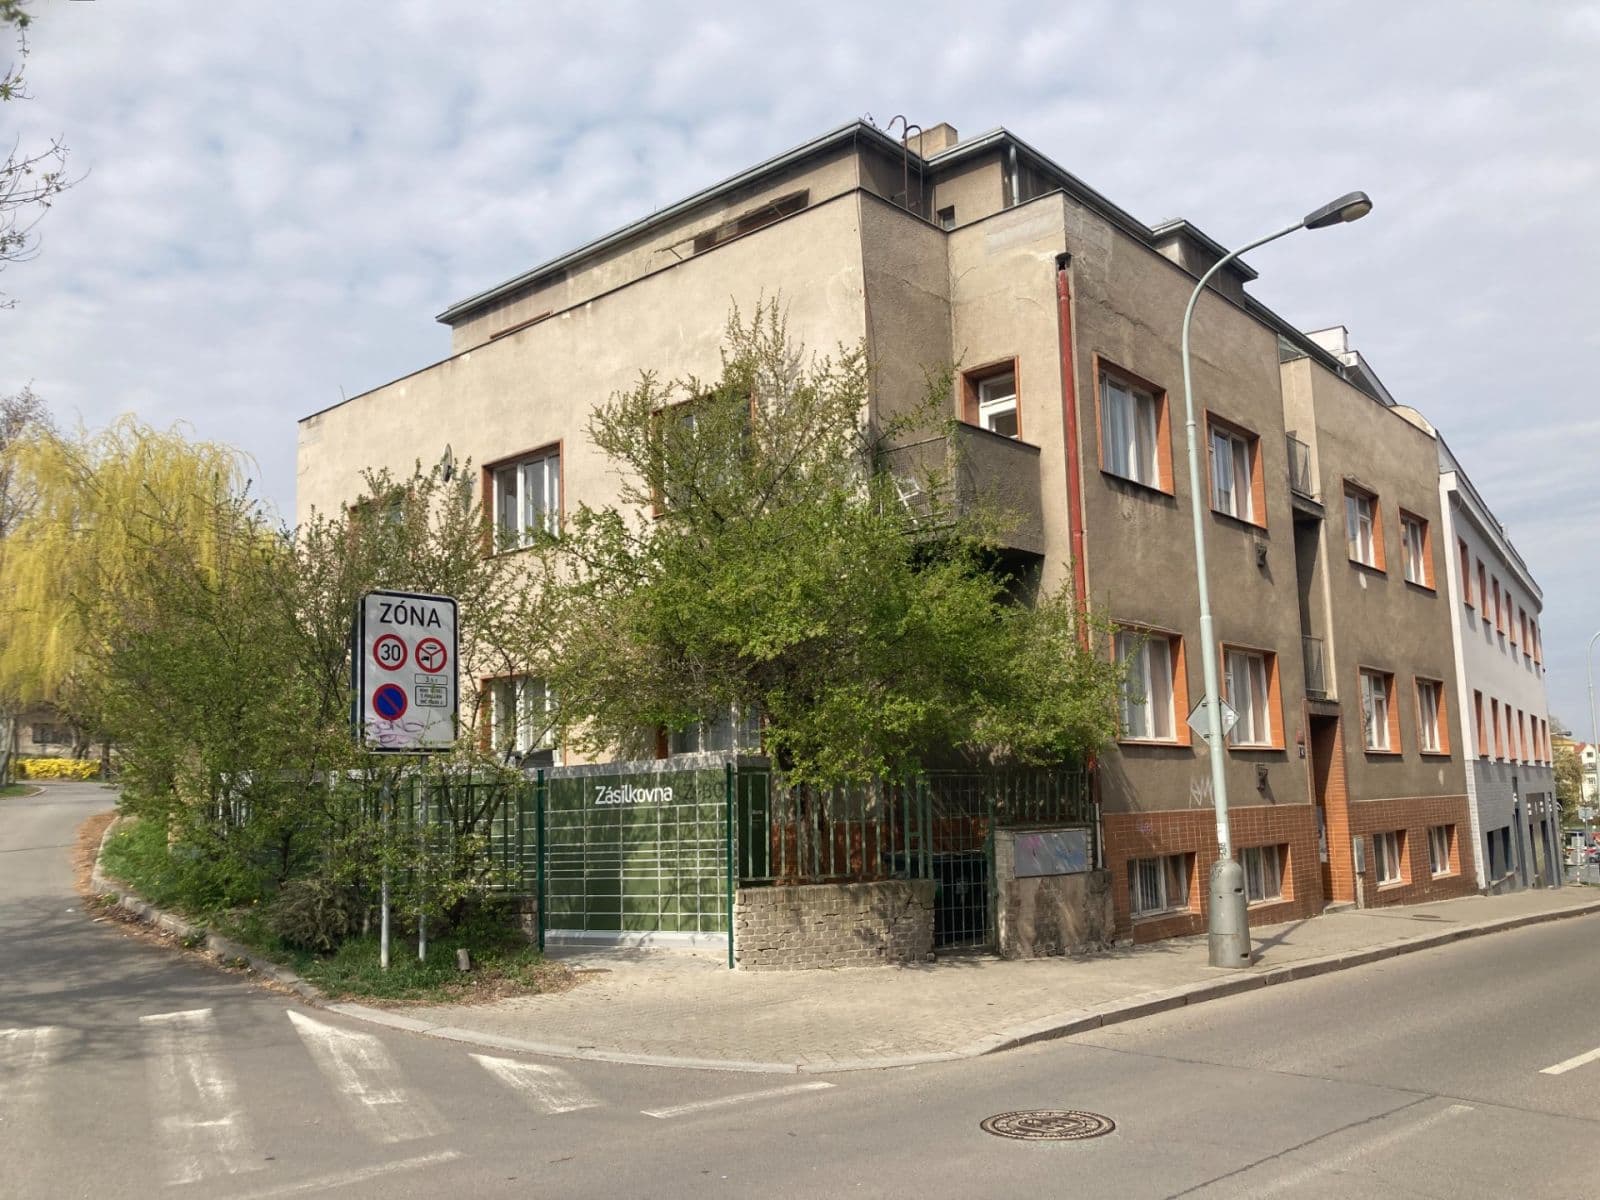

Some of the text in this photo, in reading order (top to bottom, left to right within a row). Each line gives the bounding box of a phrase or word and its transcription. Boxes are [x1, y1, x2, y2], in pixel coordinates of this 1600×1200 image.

[379, 600, 441, 628] ZÓNA
[380, 643, 401, 662] 30
[594, 784, 673, 805] Zásilkovna
